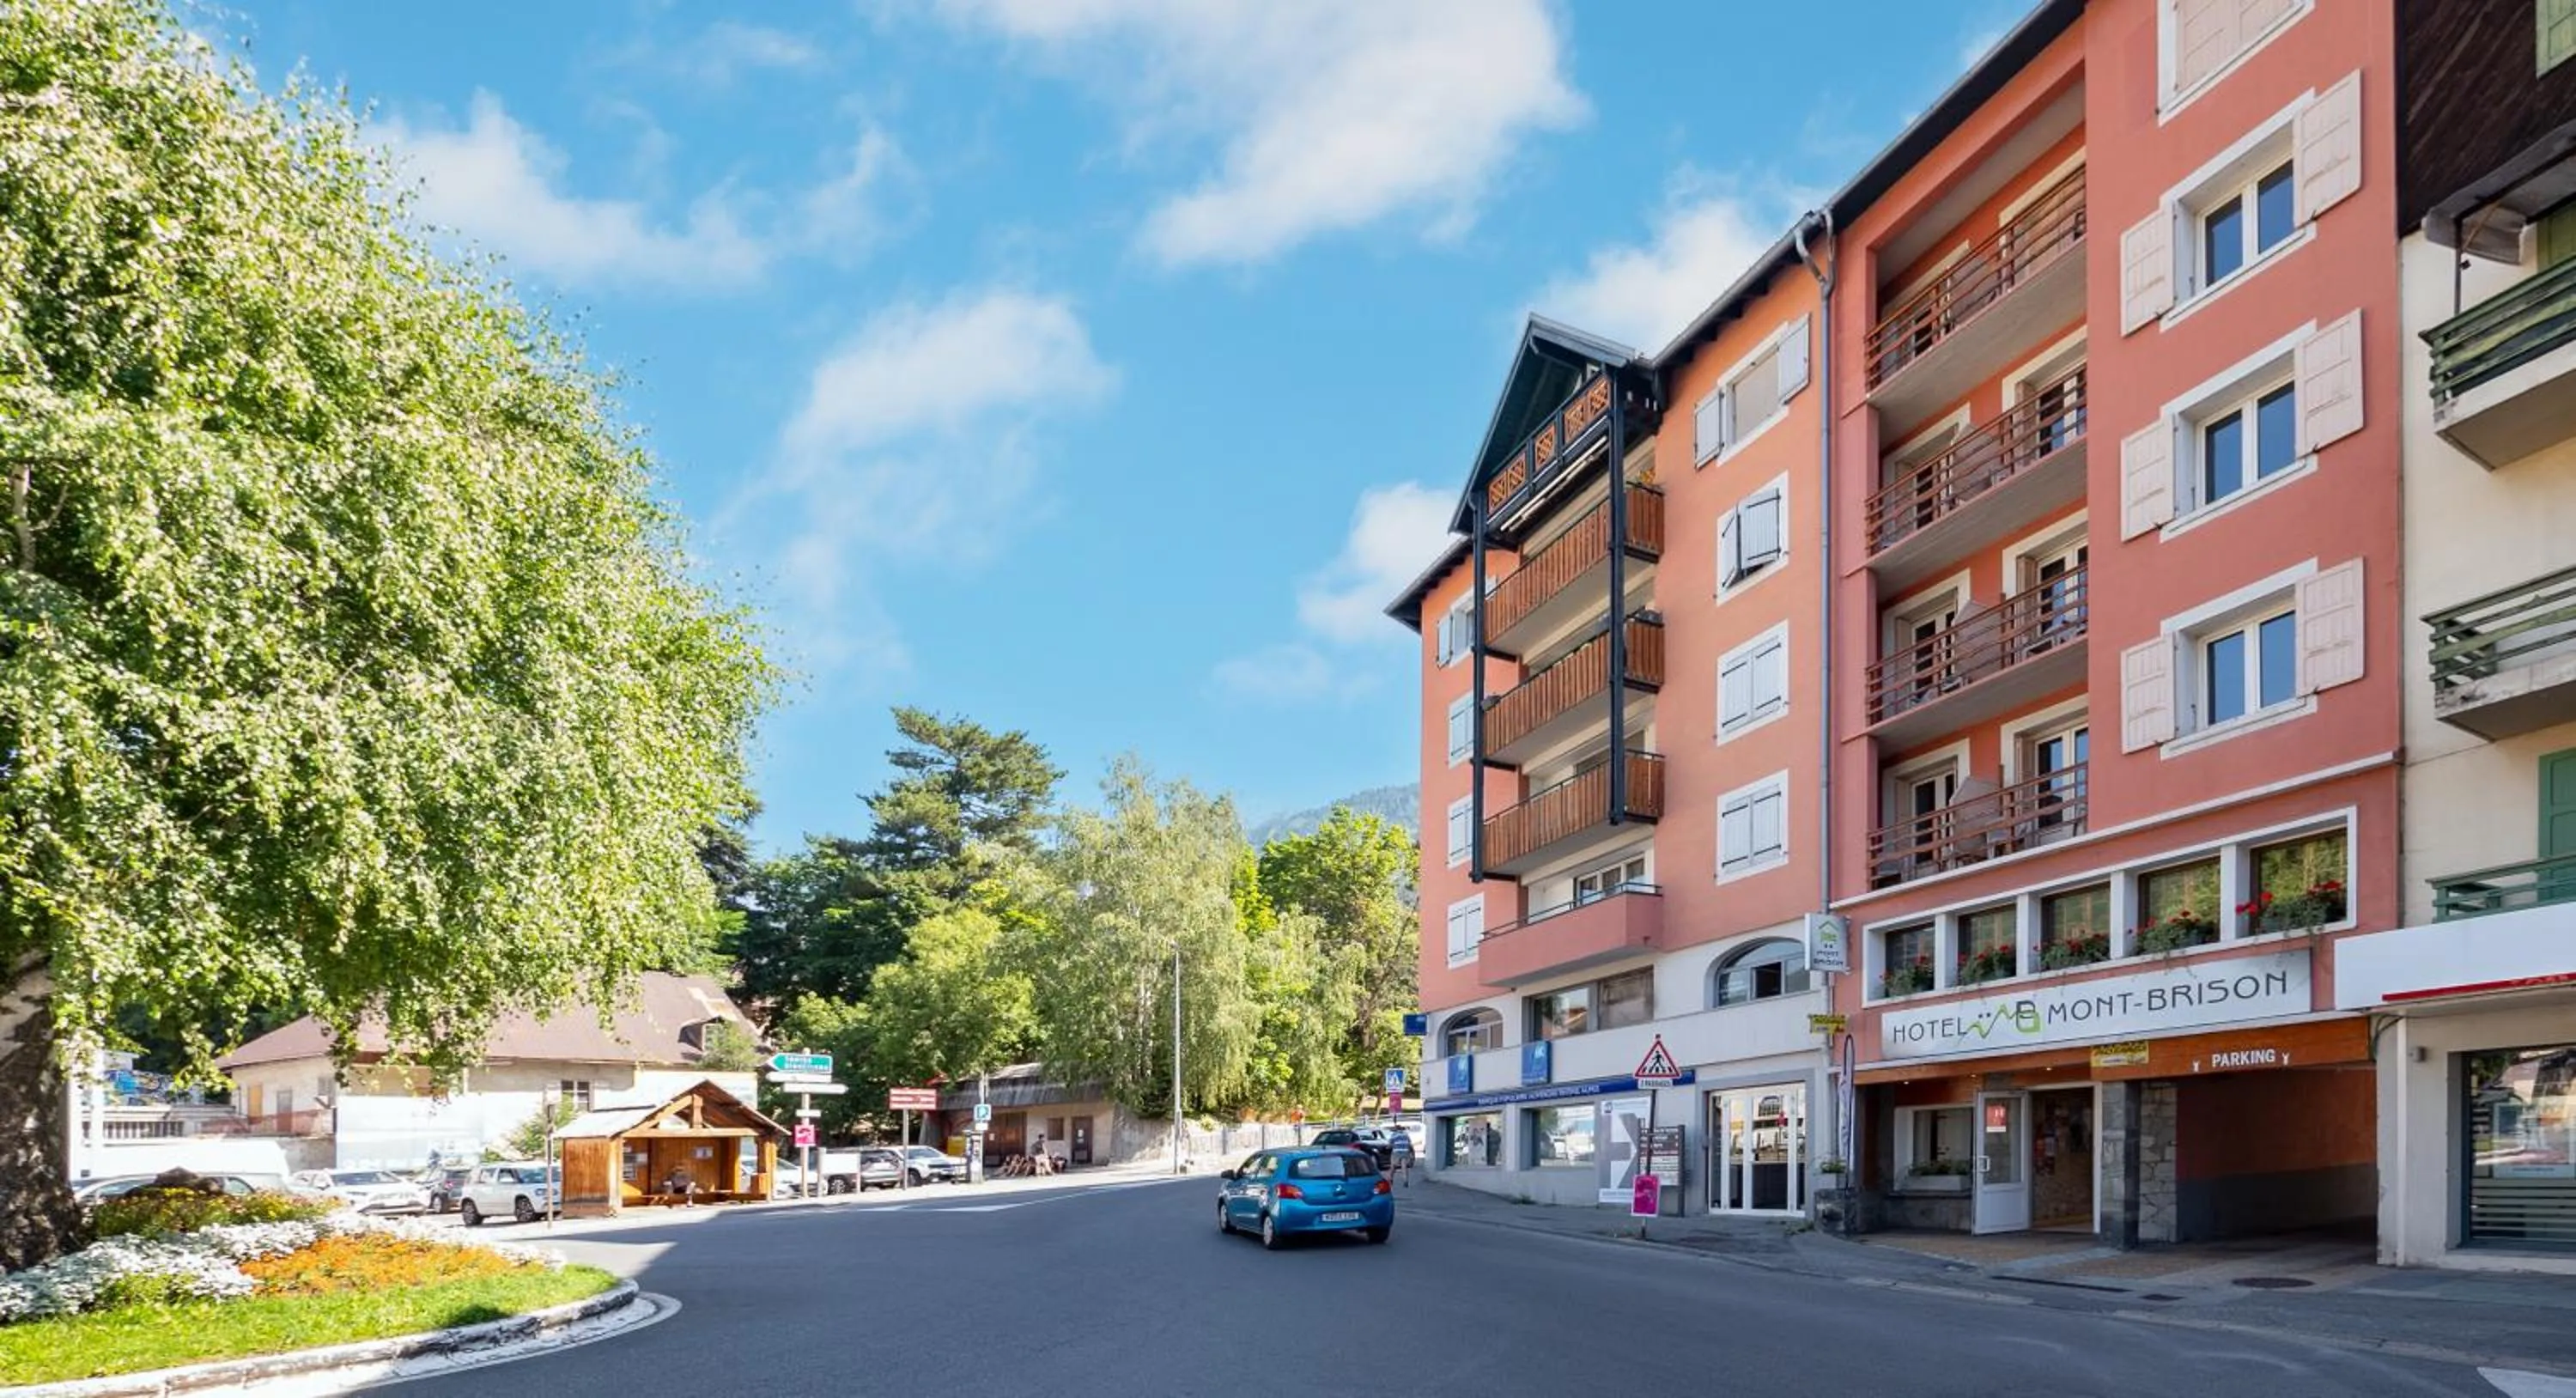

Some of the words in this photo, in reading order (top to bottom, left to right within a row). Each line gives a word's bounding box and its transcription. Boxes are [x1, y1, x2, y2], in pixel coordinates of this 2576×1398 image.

[1893, 1017, 1967, 1044] HOTEL
[2048, 970, 2287, 1024] MONT-BRISON
[2212, 1048, 2275, 1067] PARKING
